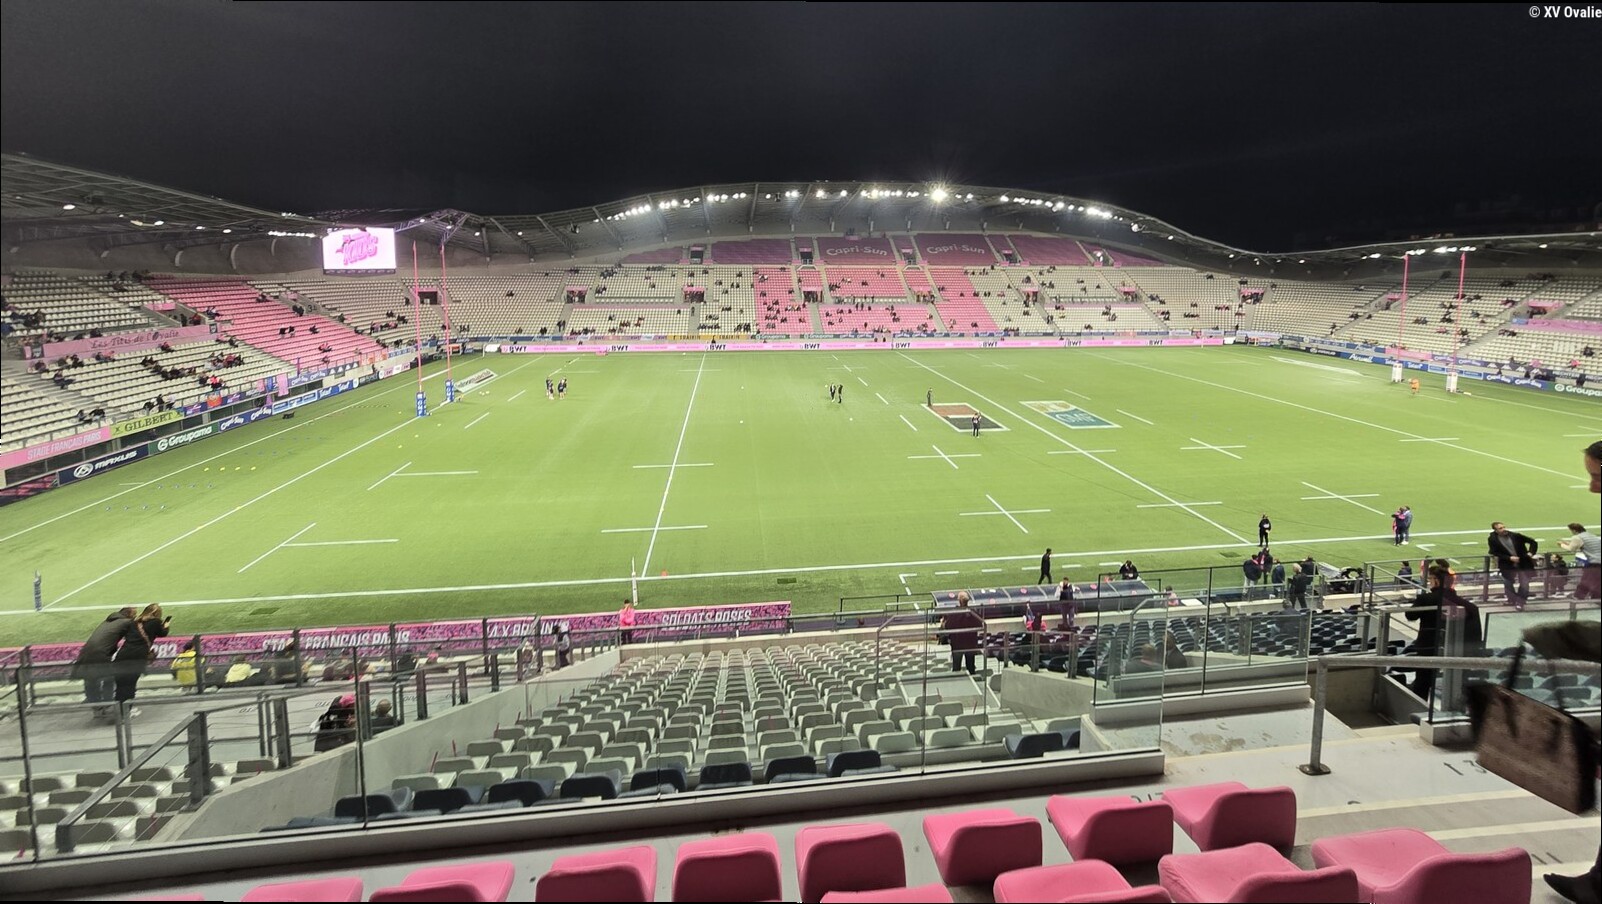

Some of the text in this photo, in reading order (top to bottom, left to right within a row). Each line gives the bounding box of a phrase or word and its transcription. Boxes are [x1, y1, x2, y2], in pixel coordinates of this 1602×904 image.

[826, 245, 888, 256] Capri-Sun
[926, 243, 985, 255] Capri-Sun
[1566, 385, 1602, 397] Groupa
[124, 412, 173, 432] GILBERT
[168, 426, 213, 446] Groupama
[27, 445, 50, 461] STADE
[83, 430, 102, 444] PARIS
